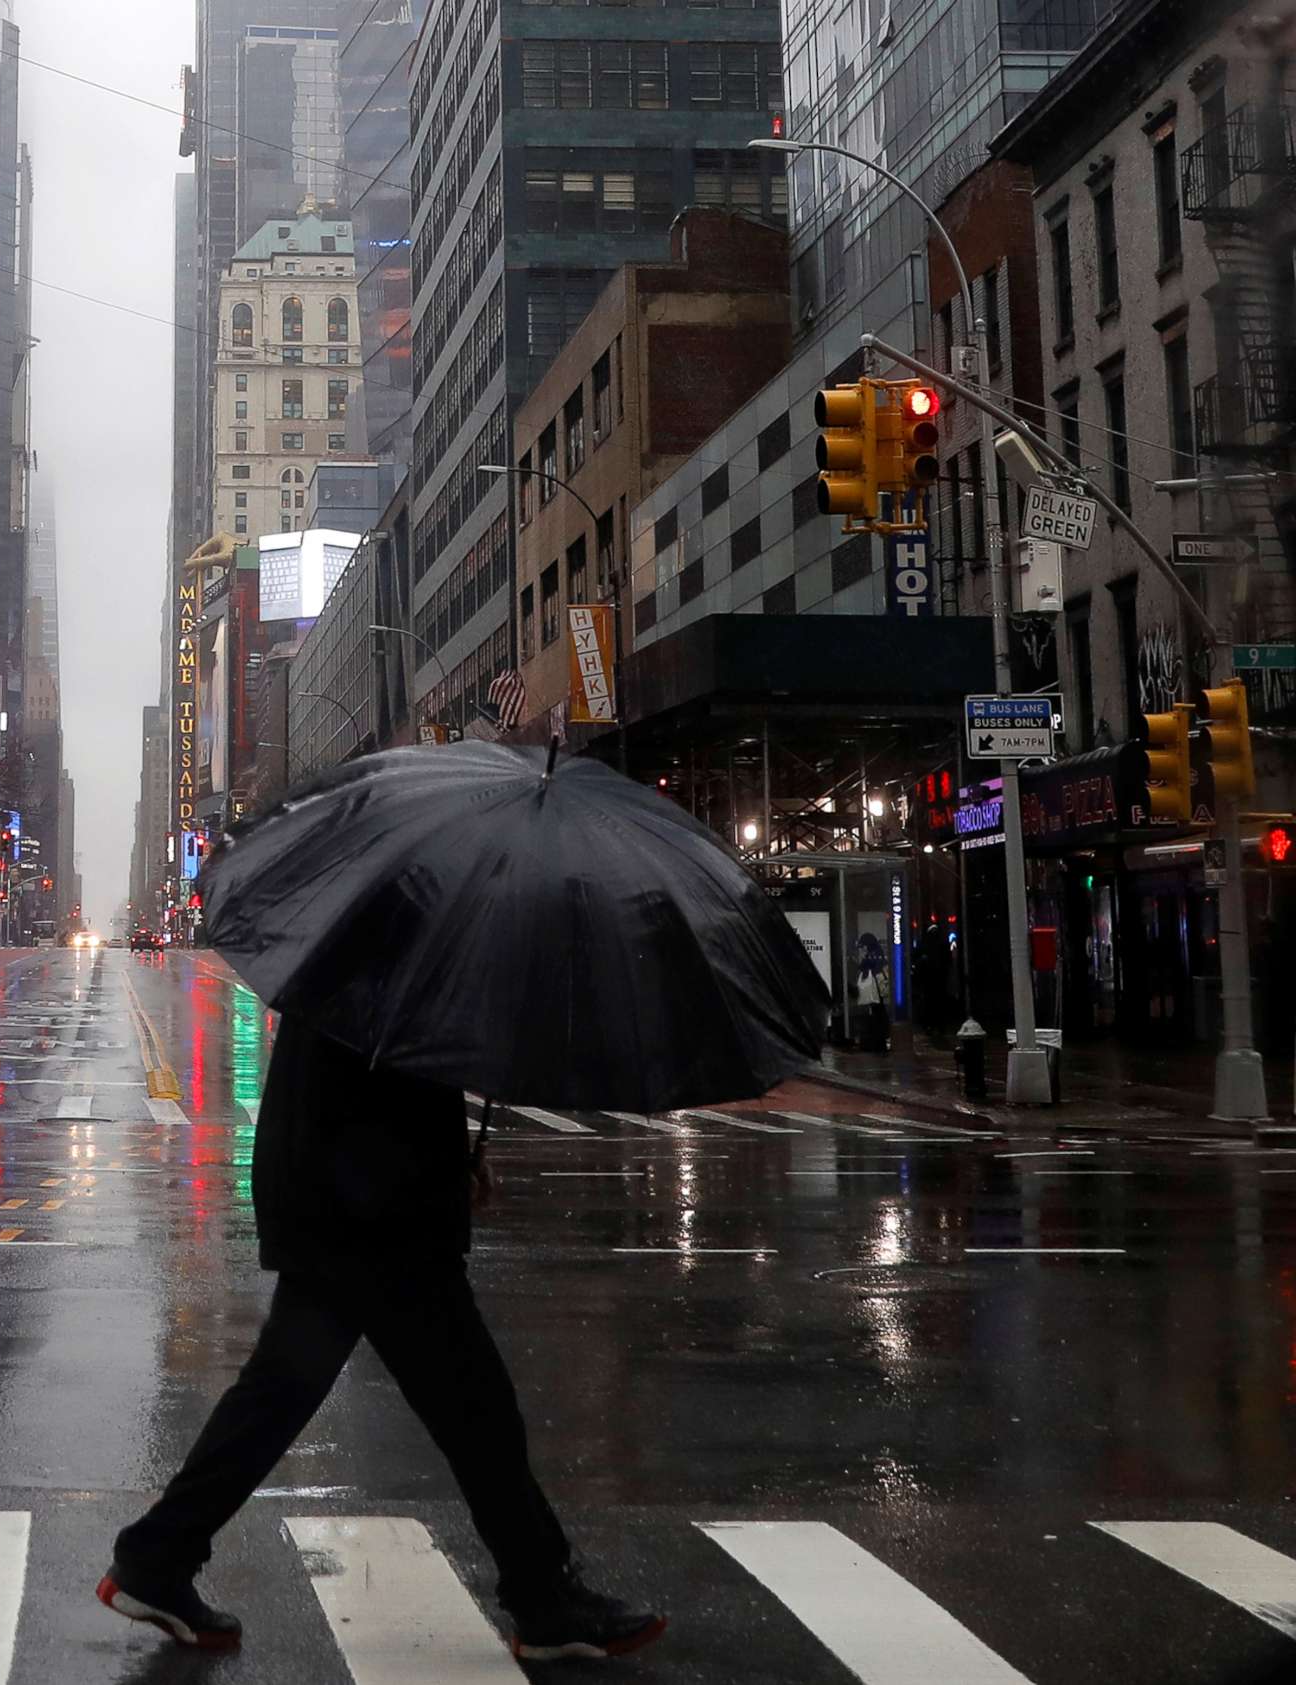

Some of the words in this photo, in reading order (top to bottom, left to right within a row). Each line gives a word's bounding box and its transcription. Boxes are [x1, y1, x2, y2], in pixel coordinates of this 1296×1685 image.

[1032, 494, 1091, 522] DELAYED
[1031, 515, 1087, 542] GREEN
[1185, 543, 1211, 555] ONE
[179, 585, 195, 684] MADAME
[1248, 648, 1260, 665] 9
[989, 703, 1012, 714] BUS
[1014, 703, 1044, 714] LANE
[974, 718, 1011, 728] BUSES
[1014, 718, 1044, 728] ONLY
[1001, 737, 1046, 747] 7AM-7PM
[954, 806, 983, 834] TOBACCO
[982, 802, 1001, 829] SHOP
[893, 913, 902, 945] Avenue
